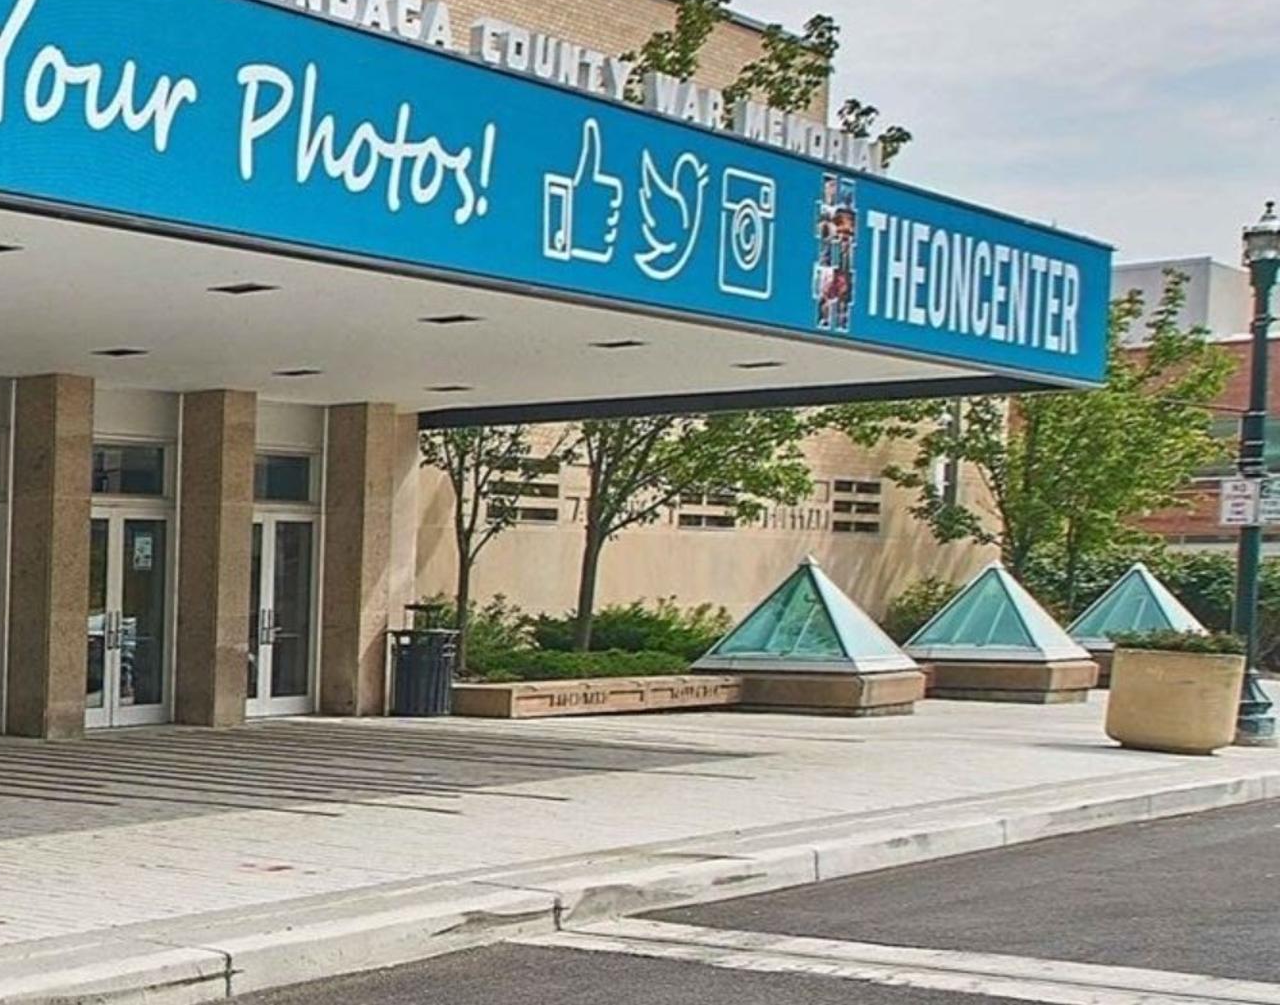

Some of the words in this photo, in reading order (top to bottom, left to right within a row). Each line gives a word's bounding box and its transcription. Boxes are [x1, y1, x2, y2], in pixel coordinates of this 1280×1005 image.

[237, 62, 496, 224] Photos!
[471, 15, 634, 102] COUNTY
[643, 69, 725, 132] WAR
[866, 209, 1080, 355] THEONCENTER
